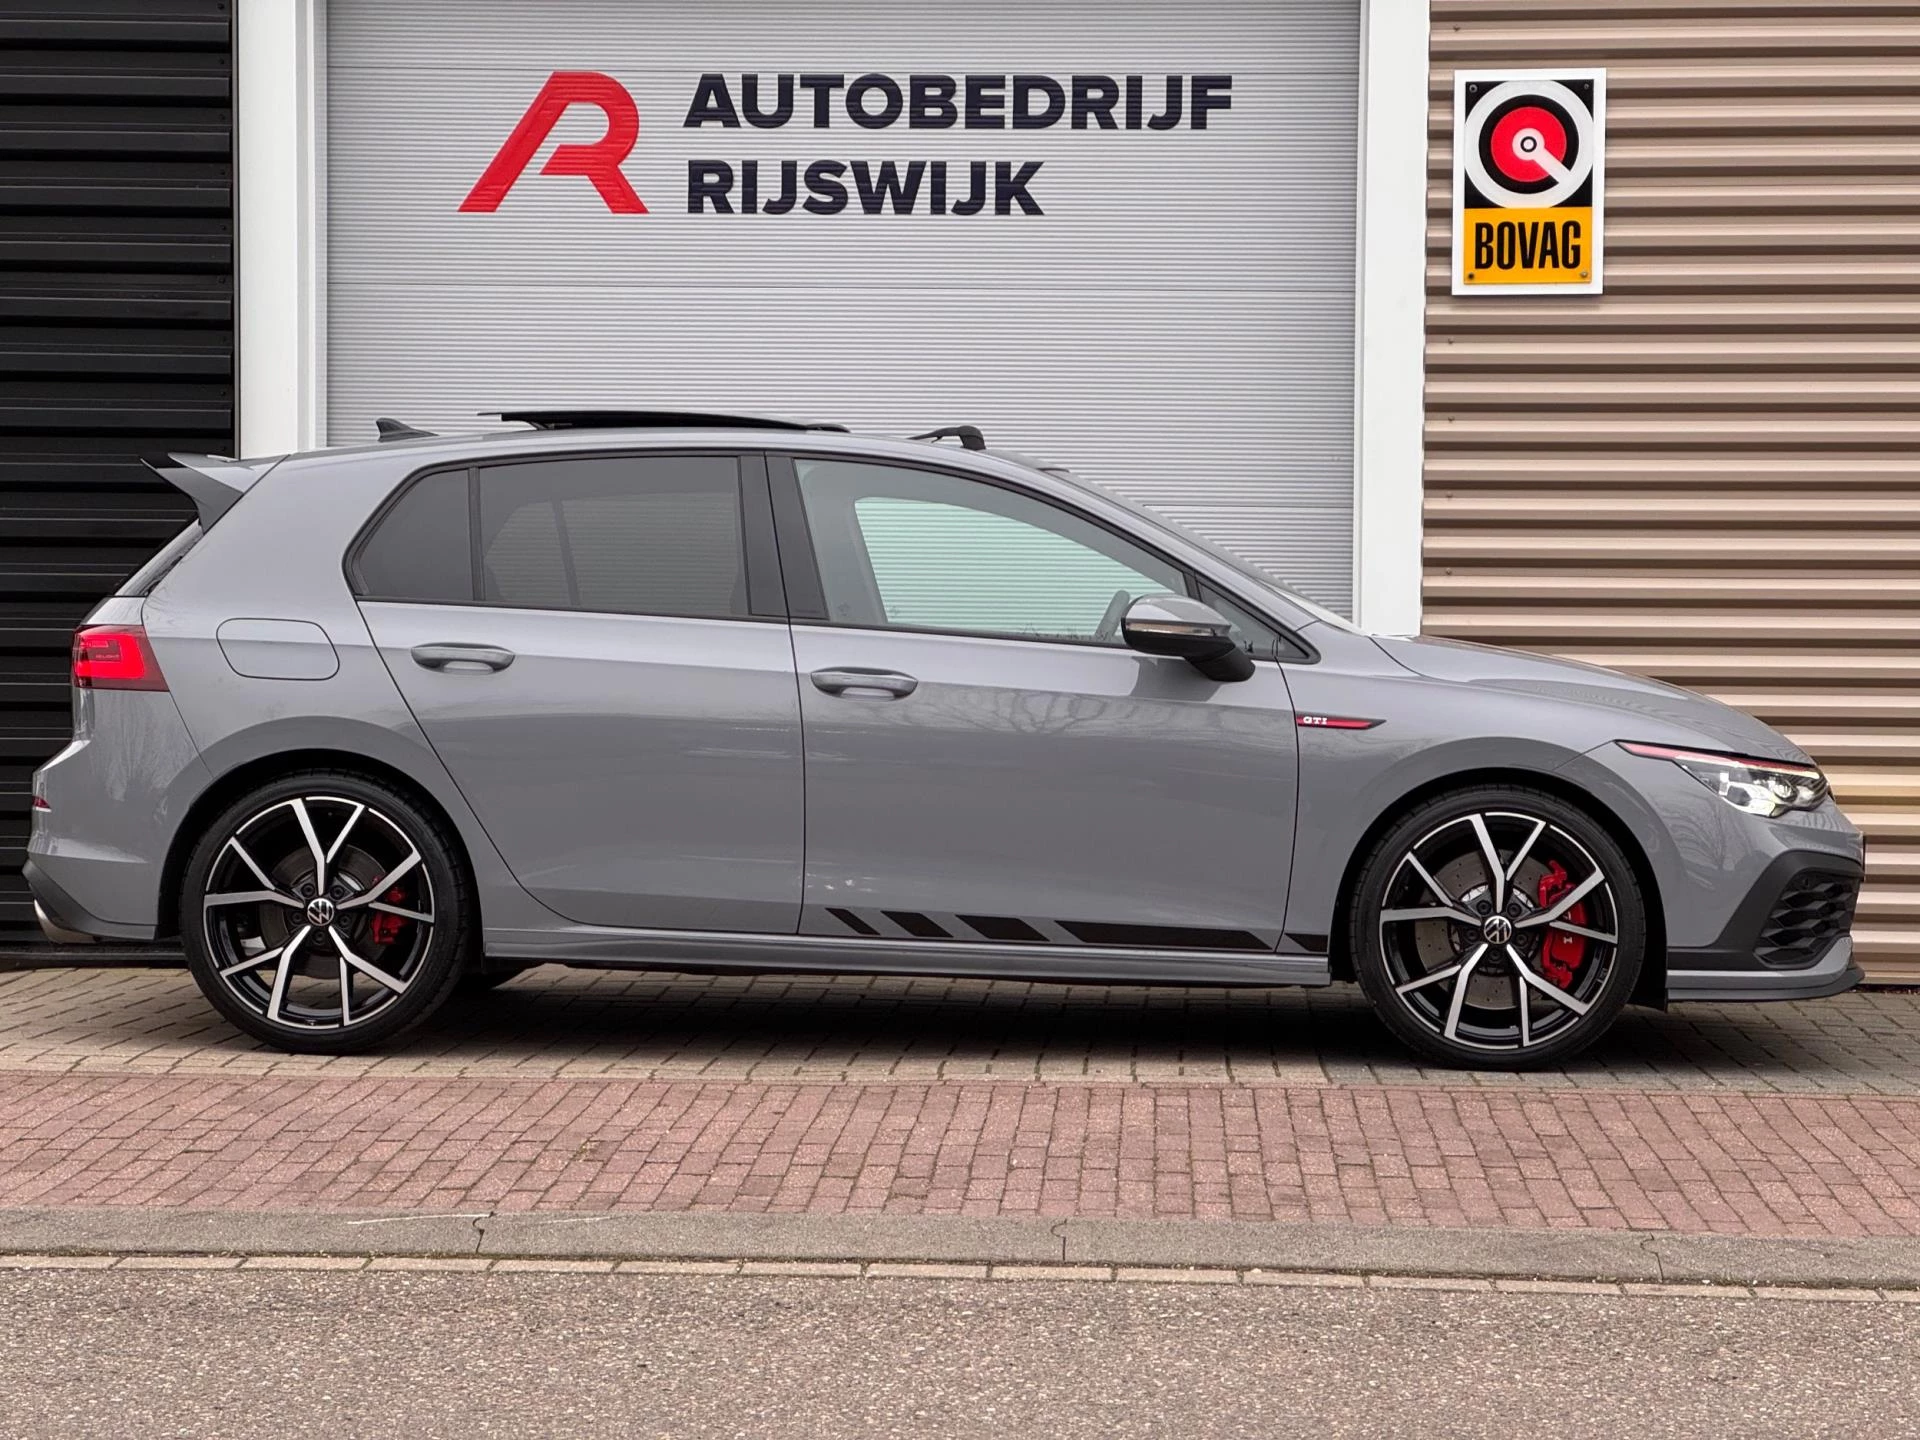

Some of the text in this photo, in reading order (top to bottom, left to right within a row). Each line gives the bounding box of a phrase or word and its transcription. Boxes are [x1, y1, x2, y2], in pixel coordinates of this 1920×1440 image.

[684, 73, 1233, 131] AUTOBEDRIJF
[687, 159, 1044, 216] RIJSWIJK
[1474, 220, 1582, 270] BOVAG
[1302, 716, 1328, 725] GTI
